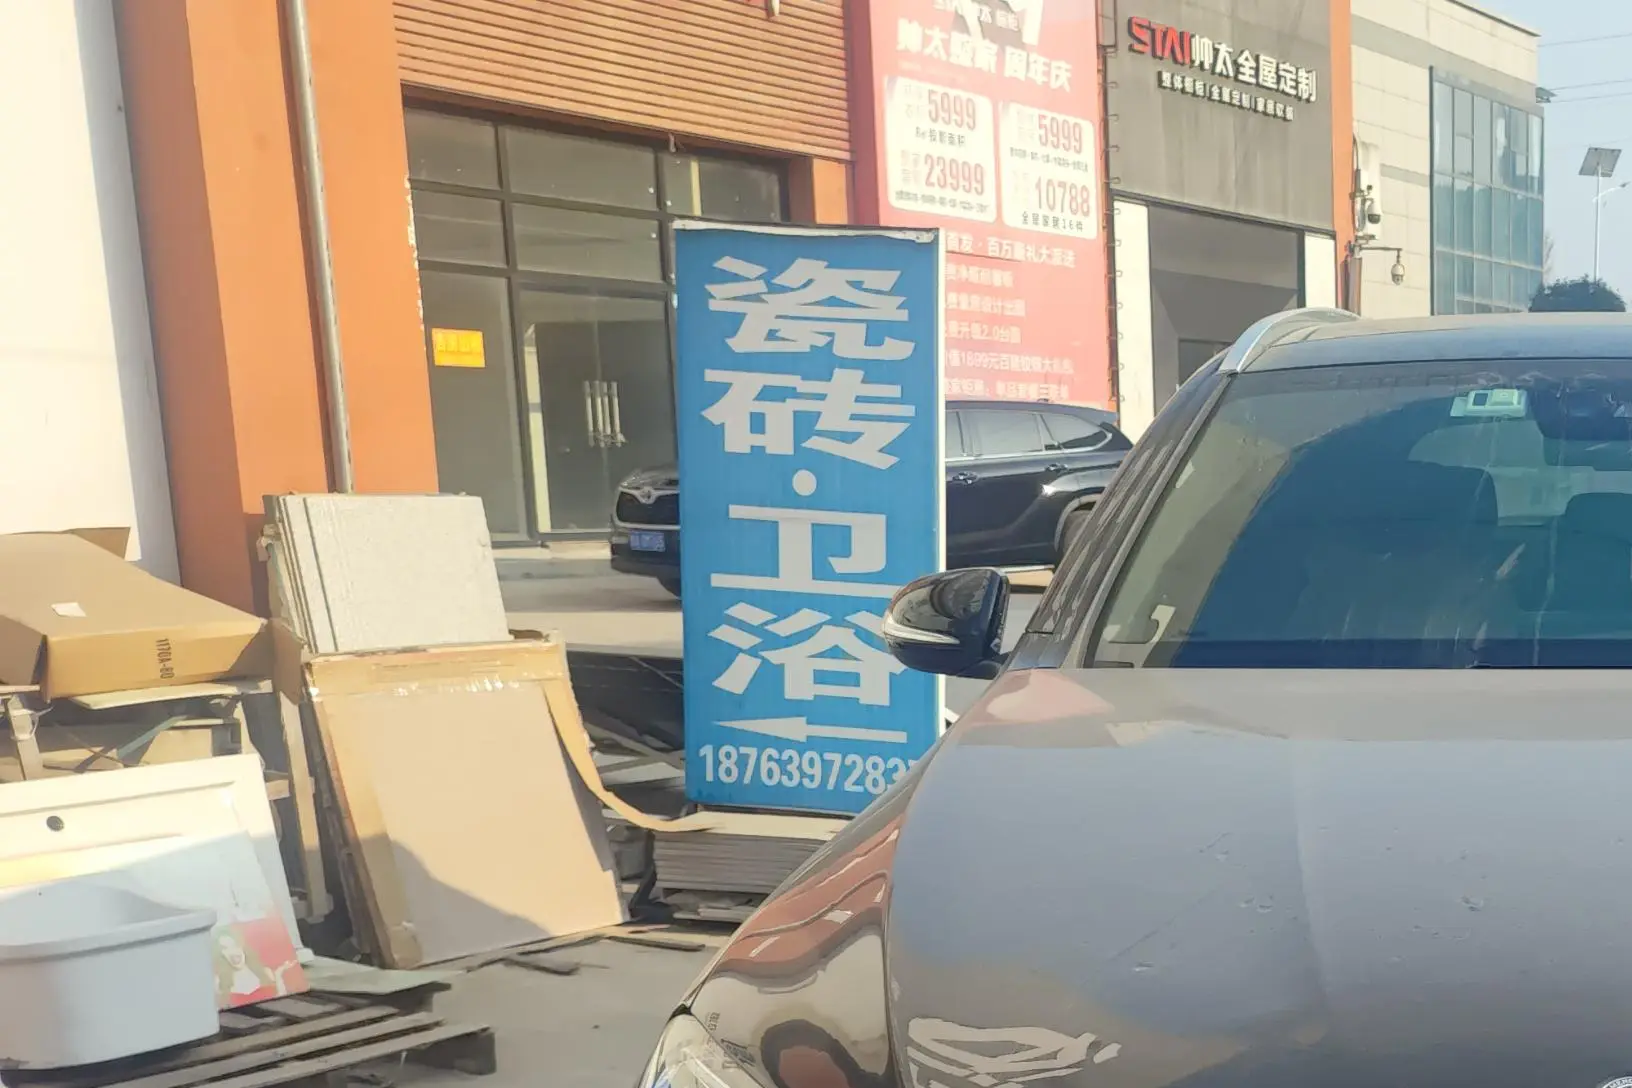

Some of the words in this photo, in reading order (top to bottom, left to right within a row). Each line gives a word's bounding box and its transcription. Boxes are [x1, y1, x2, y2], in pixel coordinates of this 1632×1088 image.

[1191, 34, 1316, 101] 帅太全屋定制
[927, 89, 977, 131] 5999
[1038, 114, 1083, 154] 5999
[924, 153, 984, 196] 23999
[1035, 176, 1091, 217] 10788
[698, 744, 920, 795] 1876397283
